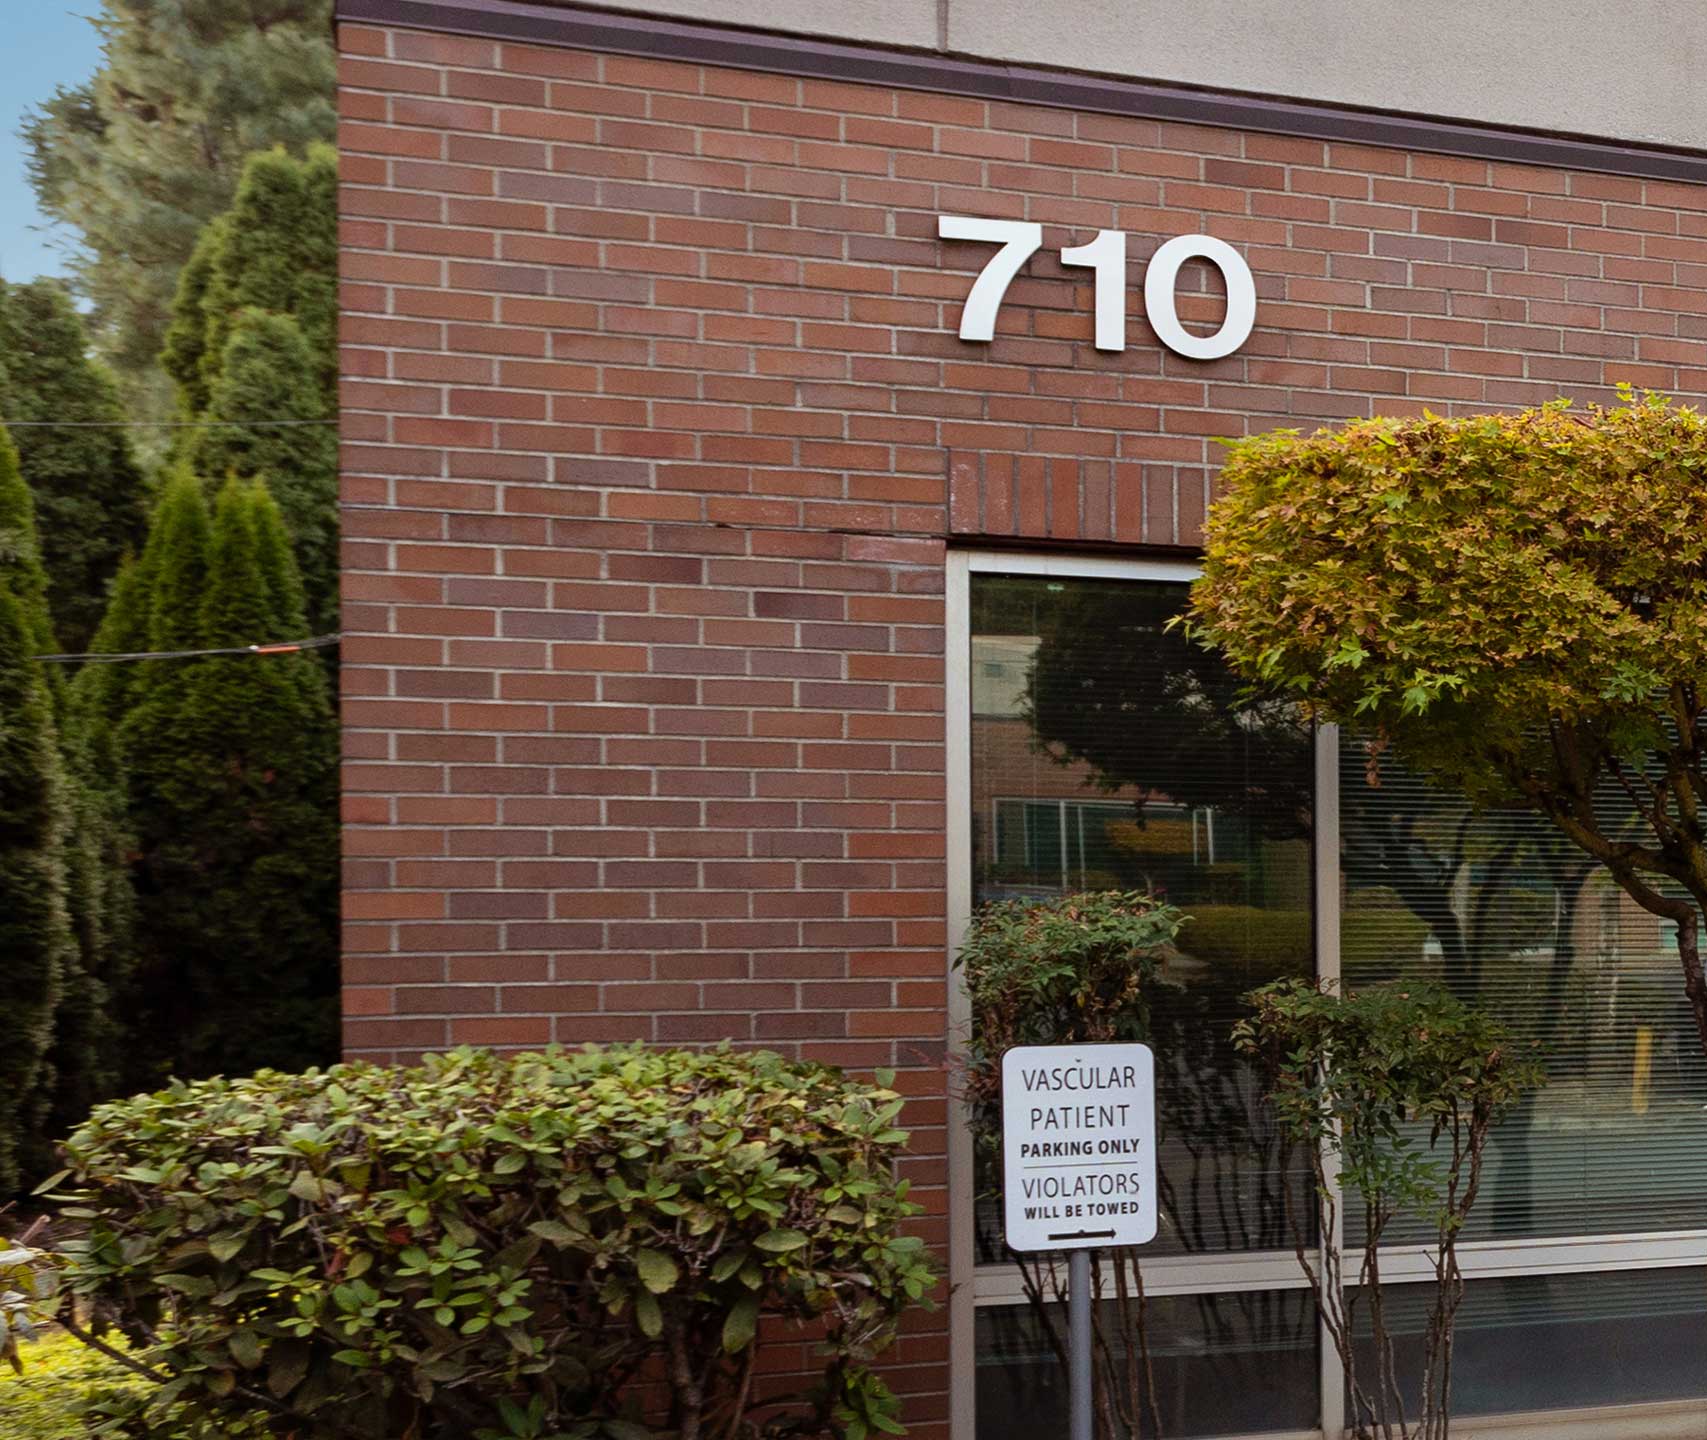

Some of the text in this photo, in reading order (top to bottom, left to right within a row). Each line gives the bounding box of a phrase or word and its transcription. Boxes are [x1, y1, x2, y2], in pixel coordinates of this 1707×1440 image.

[938, 215, 1256, 361] 710
[1021, 1066, 1136, 1091] VASCULAR
[1031, 1104, 1130, 1130] PATIENT
[1021, 1138, 1140, 1158] PARKING ONLY
[1022, 1173, 1141, 1199] VIOLATORS
[1024, 1201, 1140, 1220] WILL BE TOWED
